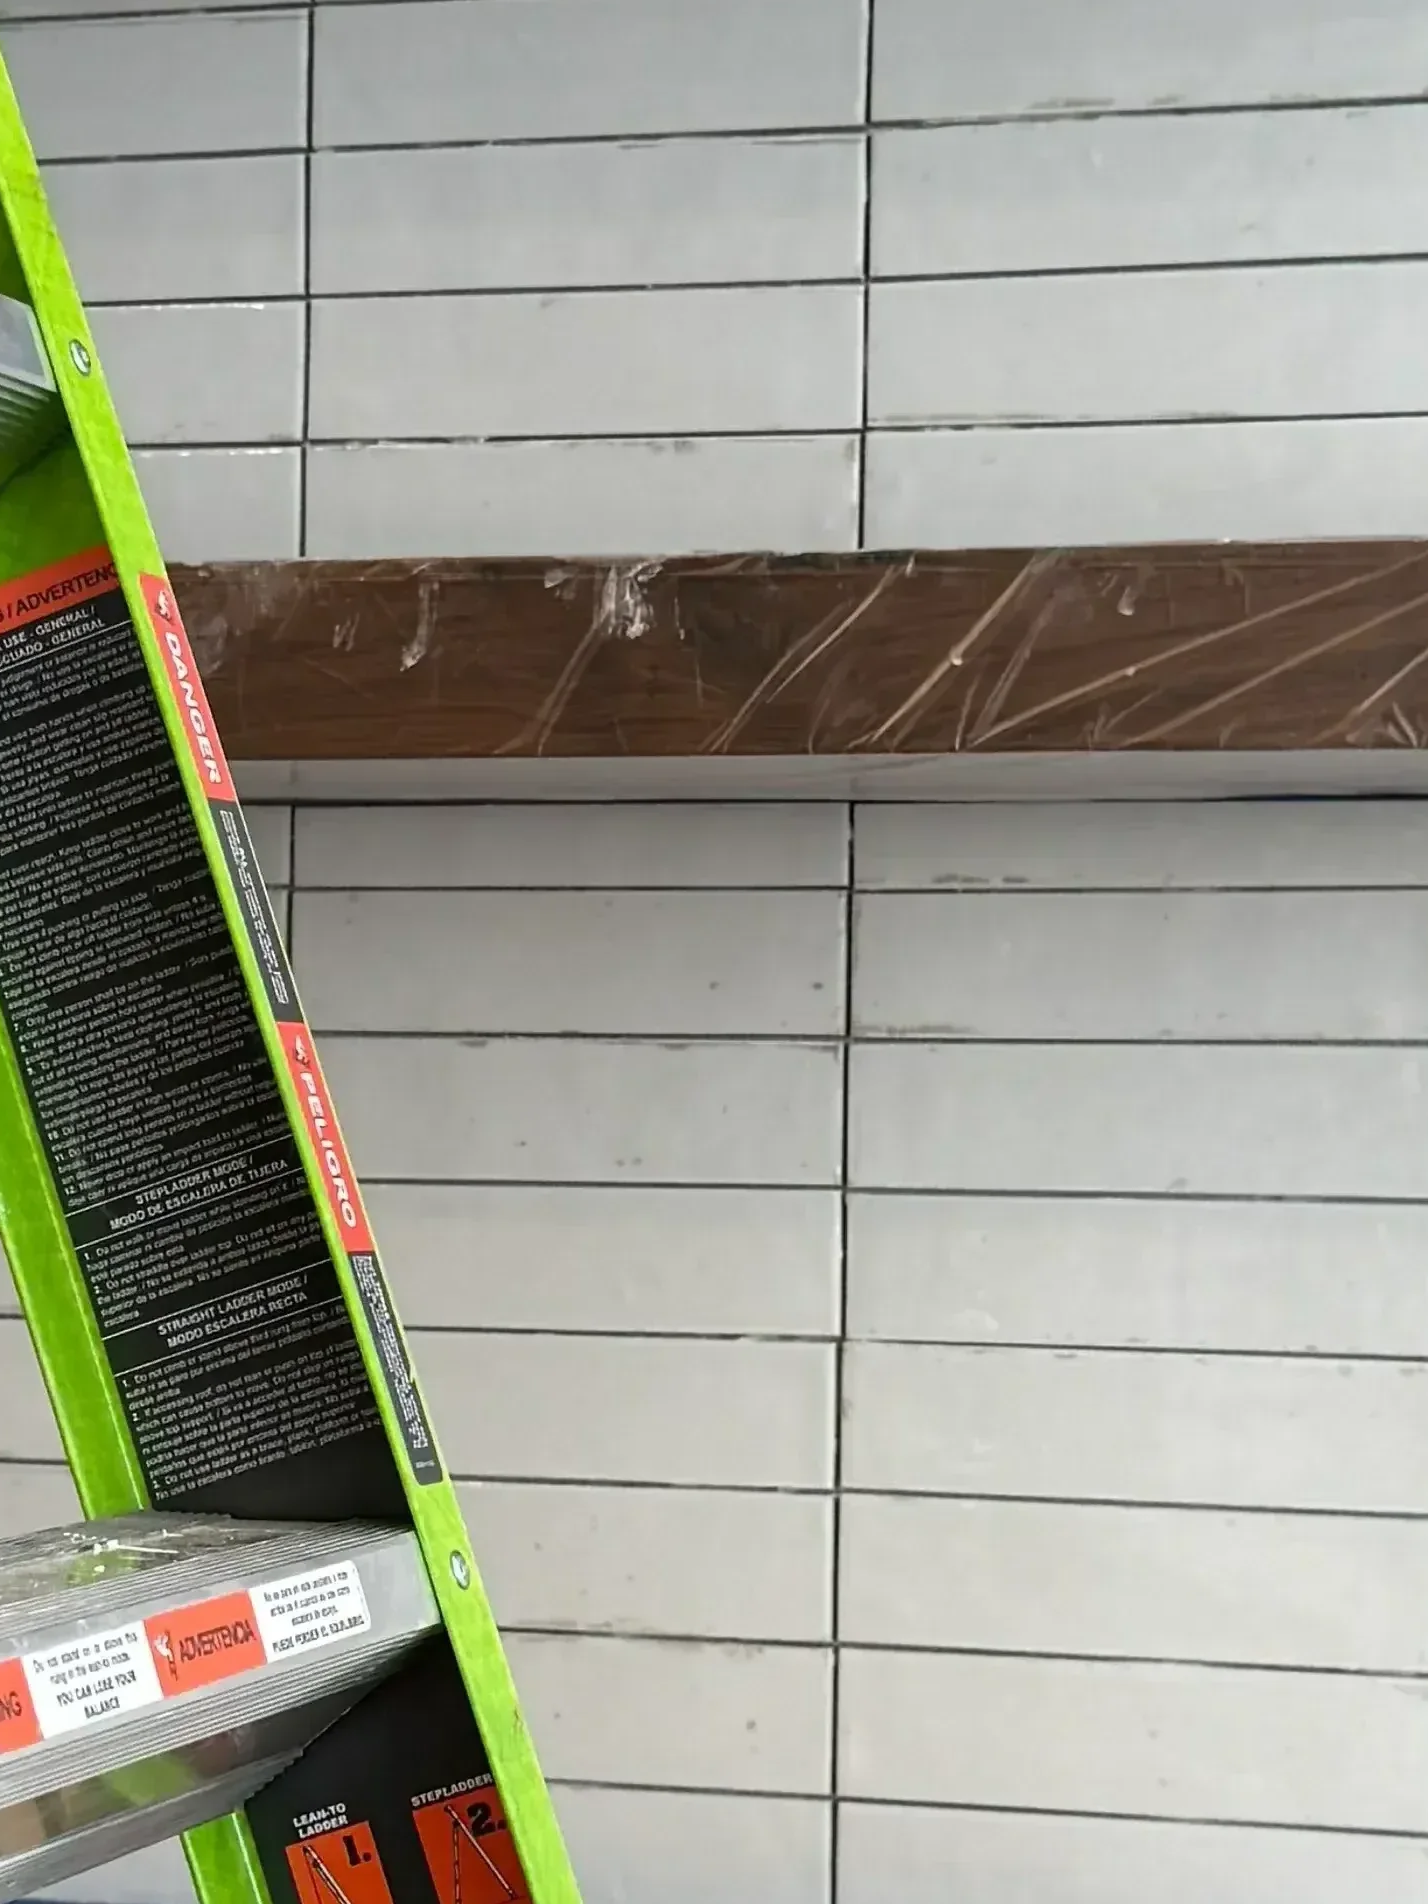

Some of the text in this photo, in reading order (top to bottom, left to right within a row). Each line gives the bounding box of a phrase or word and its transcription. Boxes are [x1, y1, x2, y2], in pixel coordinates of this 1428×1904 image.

[2, 631, 27, 648] USE
[35, 609, 88, 635] GENERAL
[51, 618, 108, 644] GENERAL
[165, 632, 221, 782] DANGER
[300, 1072, 356, 1227] PELIGRO
[109, 1159, 288, 1230] MODO DE ESCALERA DE TIJERA
[135, 1170, 211, 1204] STEPLADDER
[212, 1157, 247, 1177] MODE
[158, 1306, 214, 1335] STRAIGHT
[217, 1289, 265, 1314] LADDER
[266, 1276, 302, 1296] MODE
[167, 1292, 307, 1347] MODO ESCALERA RECTA
[179, 1620, 255, 1662] ADVERTENCIA
[411, 1773, 492, 1806] STEPLADDER
[293, 1803, 346, 1827] LEAN-TO
[295, 1814, 348, 1838] LADDER
